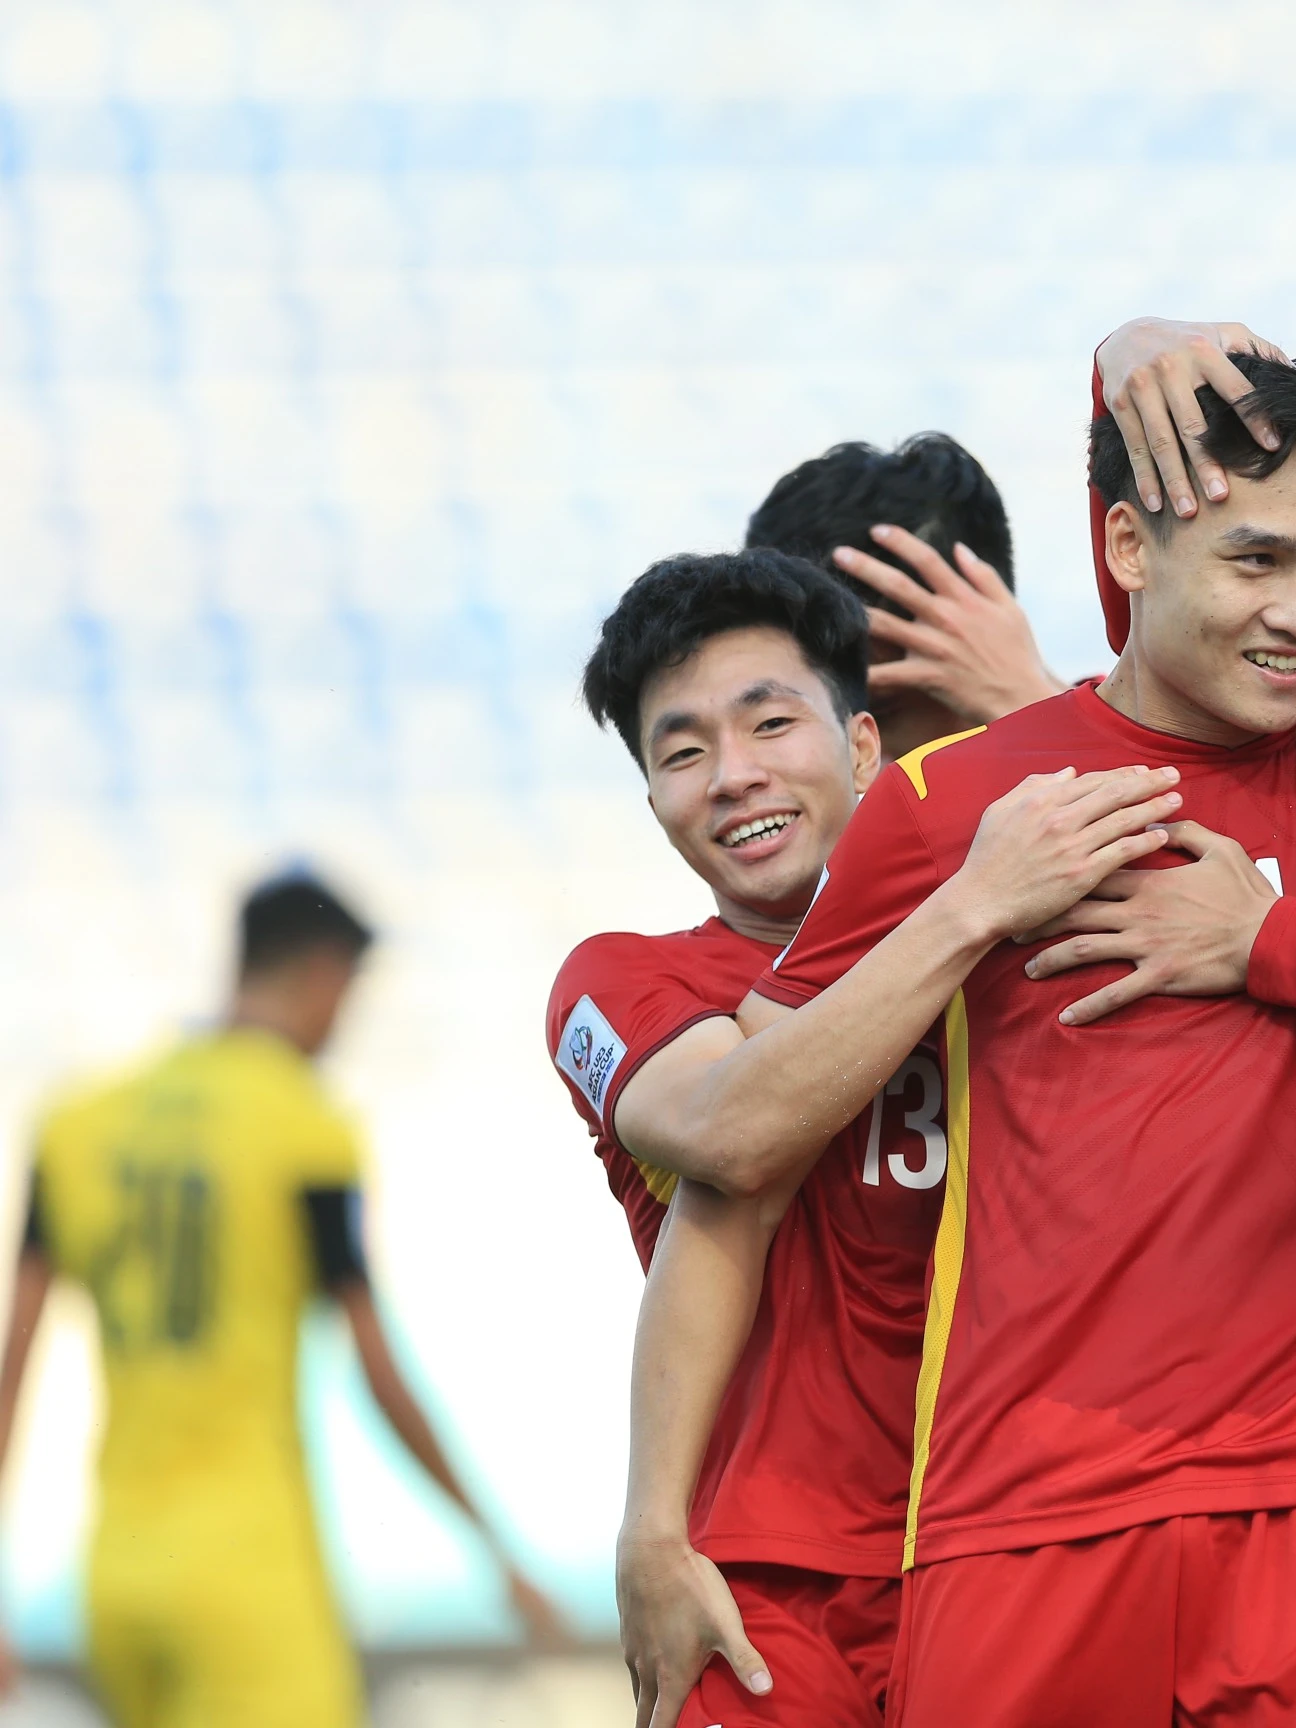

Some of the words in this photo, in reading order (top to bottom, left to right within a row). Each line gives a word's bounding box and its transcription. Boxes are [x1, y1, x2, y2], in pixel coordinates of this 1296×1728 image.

[593, 1047, 606, 1067] U23
[592, 1070, 602, 1104] ASIAN
[862, 1055, 947, 1190] 13
